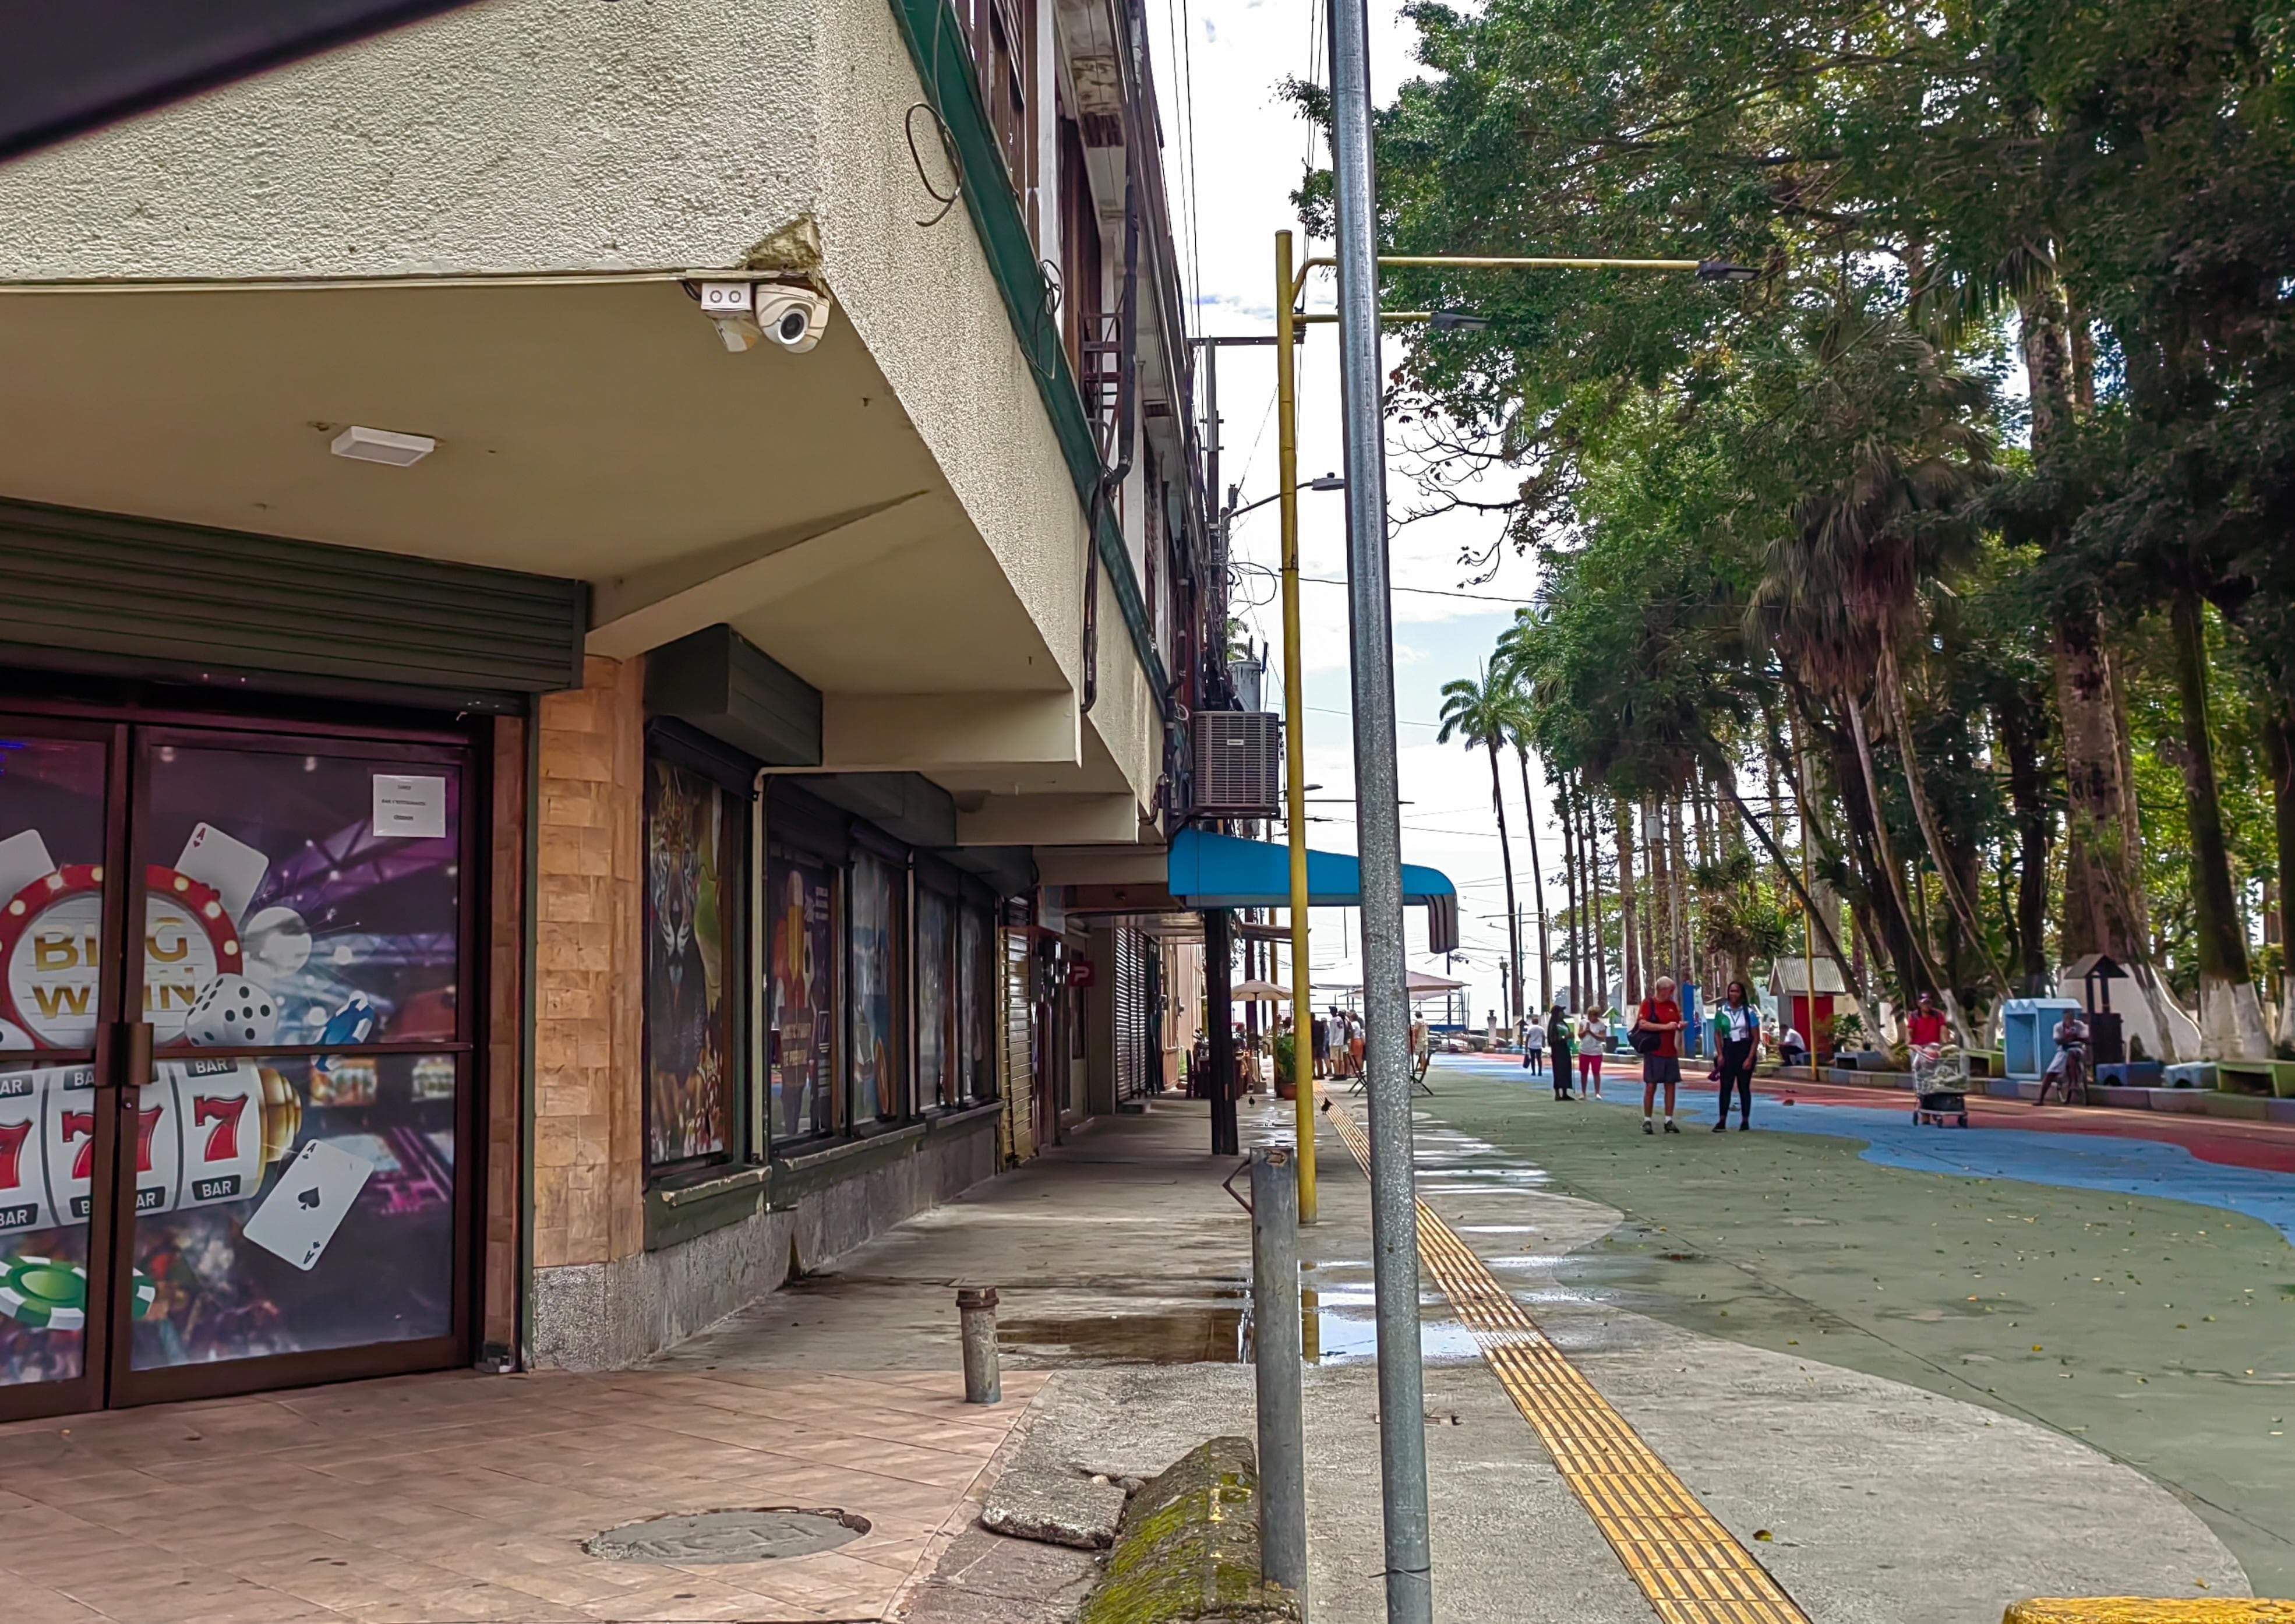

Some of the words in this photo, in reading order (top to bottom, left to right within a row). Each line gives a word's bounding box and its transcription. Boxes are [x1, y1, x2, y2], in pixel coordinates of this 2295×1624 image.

[196, 827, 206, 841] A
[34, 917, 188, 972] BIG
[196, 1059, 228, 1074] BAR
[193, 1090, 249, 1163] 7
[306, 1142, 317, 1153] A
[202, 1180, 232, 1198] BAR
